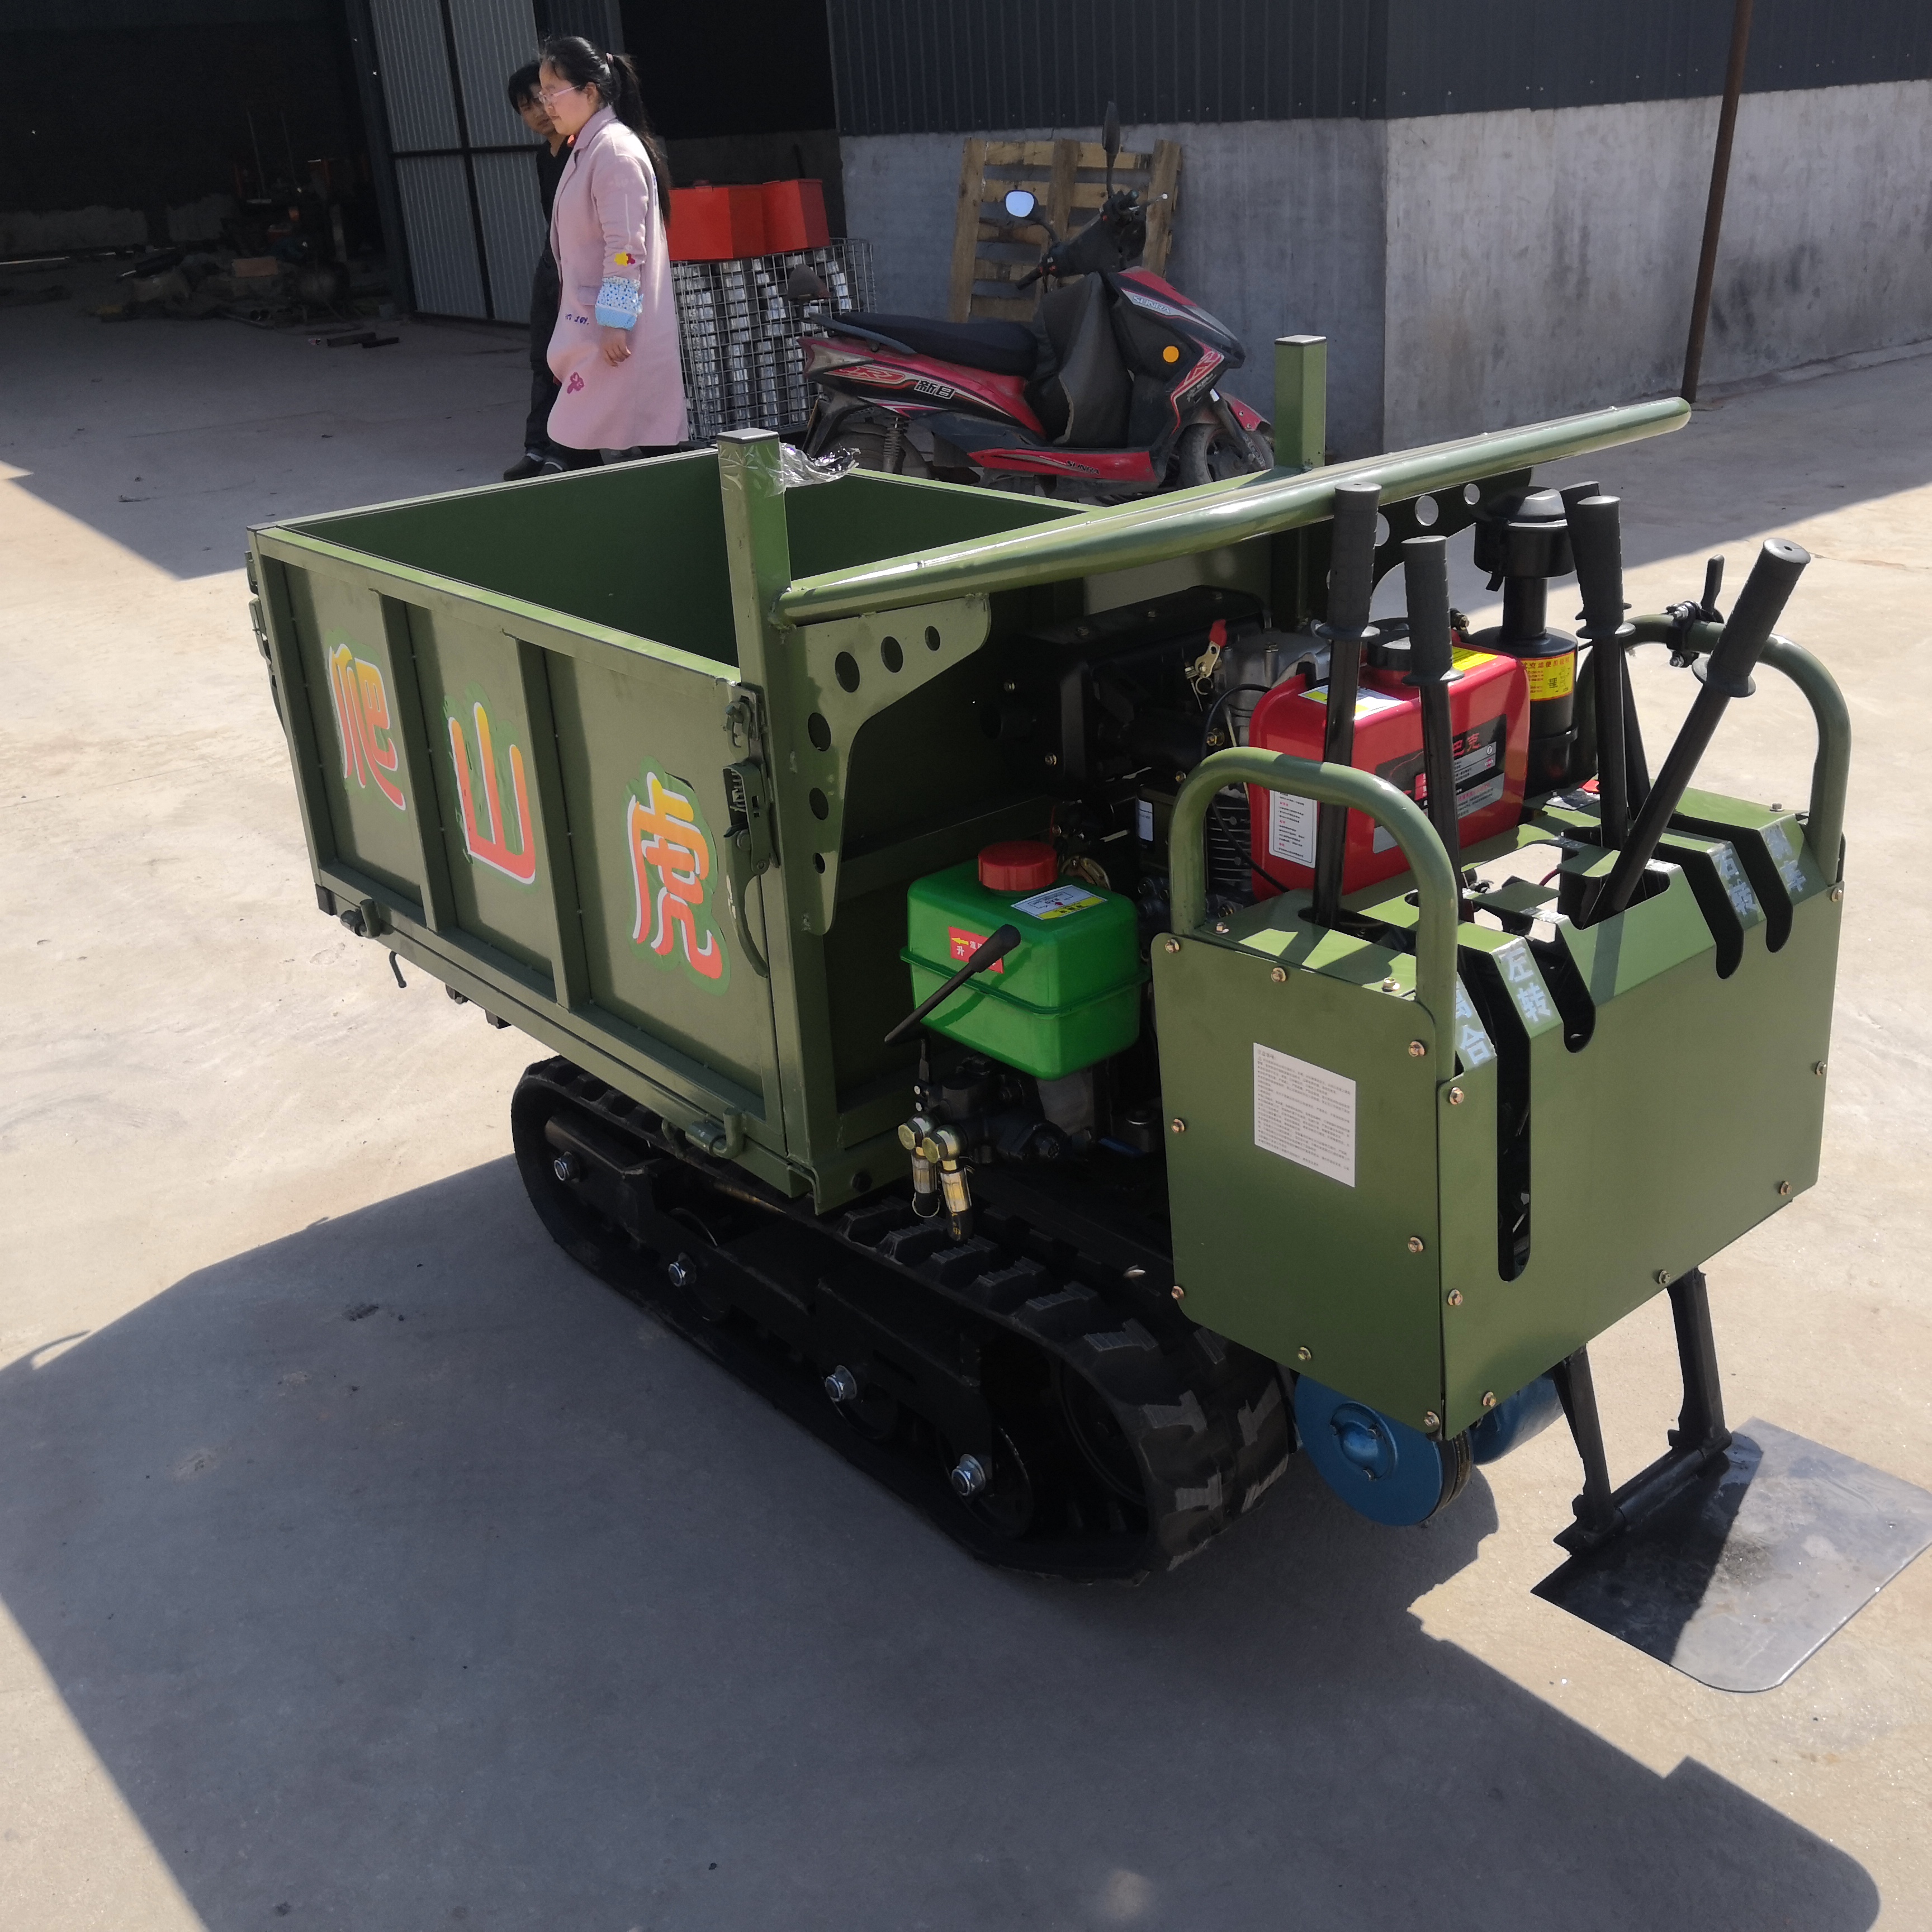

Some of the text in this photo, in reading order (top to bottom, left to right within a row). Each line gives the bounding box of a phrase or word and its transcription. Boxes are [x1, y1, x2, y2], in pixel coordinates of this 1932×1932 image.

[1133, 296, 1171, 314] SUNRA
[915, 380, 955, 399] 新日
[1067, 460, 1100, 475] SUNRA
[1712, 847, 1758, 917] 右转
[1498, 946, 1551, 1022] 左转
